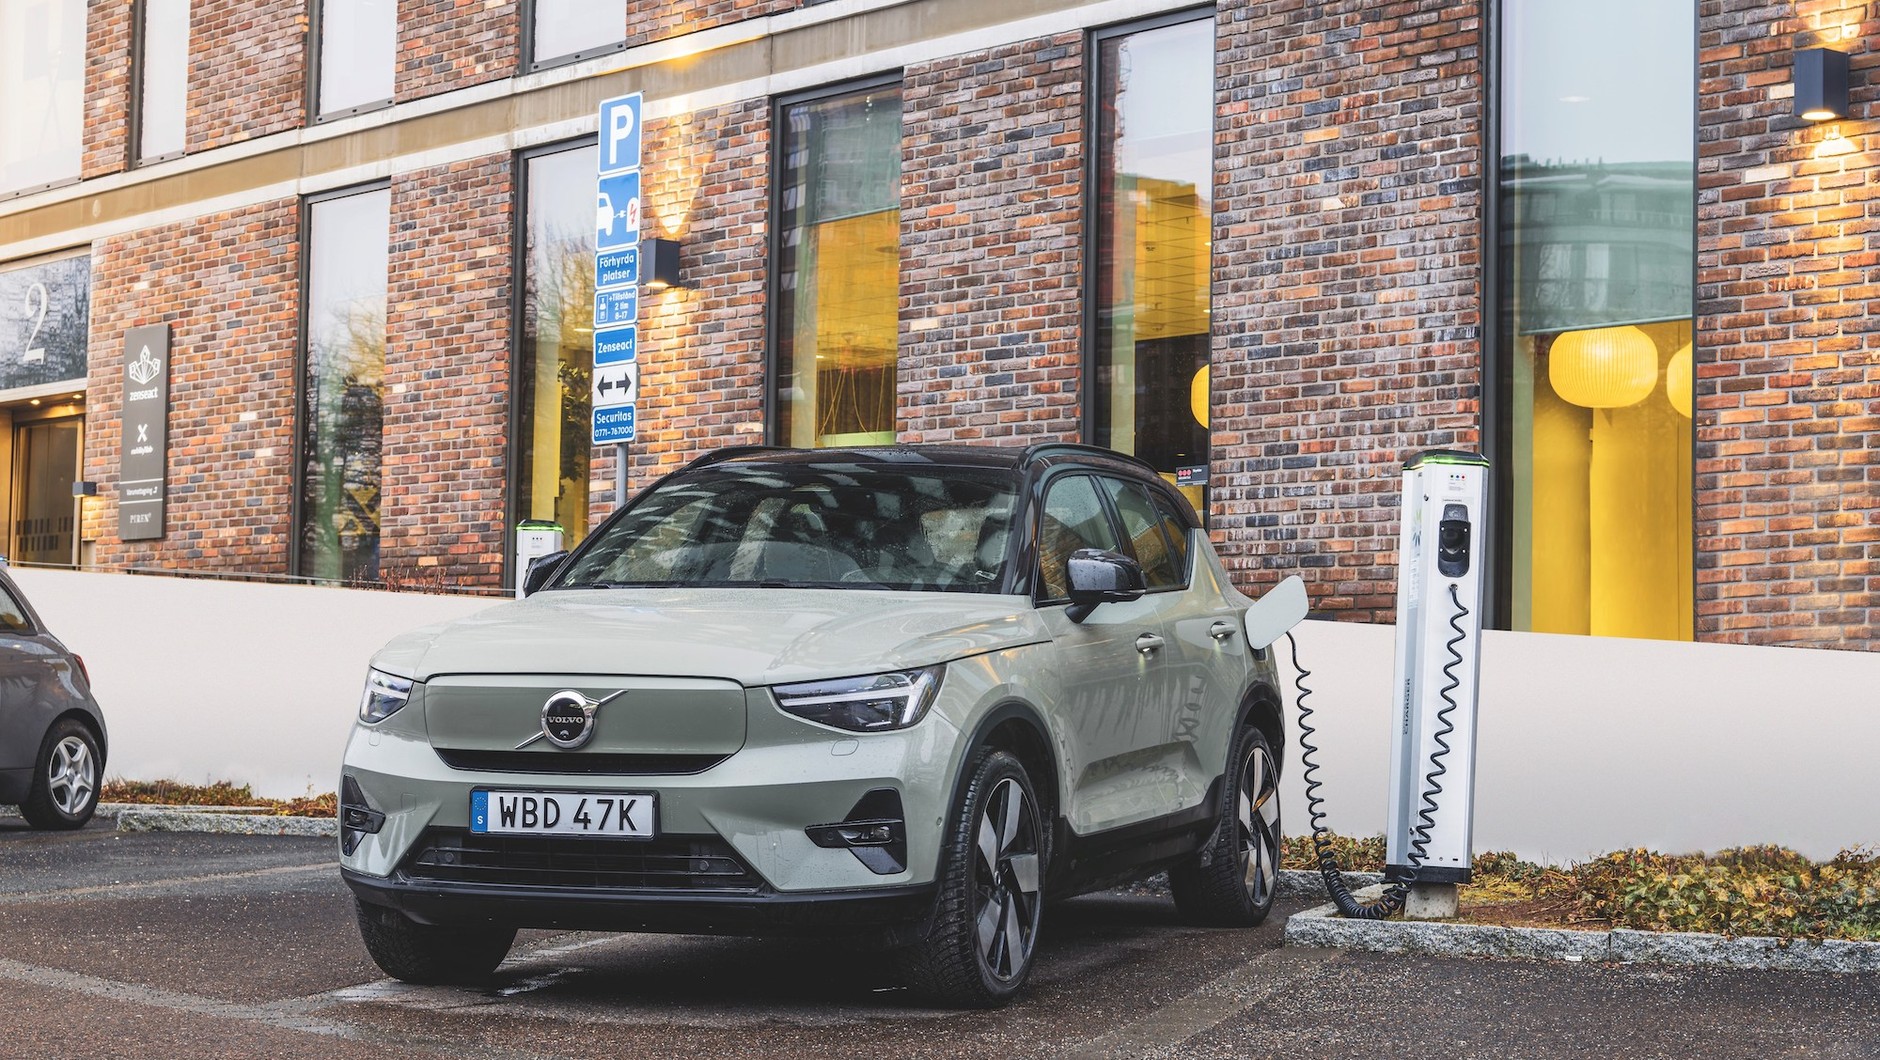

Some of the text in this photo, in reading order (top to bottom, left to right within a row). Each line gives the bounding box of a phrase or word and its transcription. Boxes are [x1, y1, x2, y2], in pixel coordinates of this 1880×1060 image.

[609, 104, 634, 165] P
[599, 253, 634, 268] Förhyrda
[602, 269, 631, 284] platser
[614, 302, 629, 311] 2 tim
[614, 311, 628, 320] 8-17
[23, 282, 48, 365] 2
[598, 338, 633, 354] Zenseact
[129, 387, 159, 402] zenseact
[596, 411, 632, 424] Securitas
[595, 426, 633, 437] 0771-767000
[547, 716, 584, 724] VOLVO
[477, 815, 484, 825] S
[499, 796, 638, 832] WBD 47K
